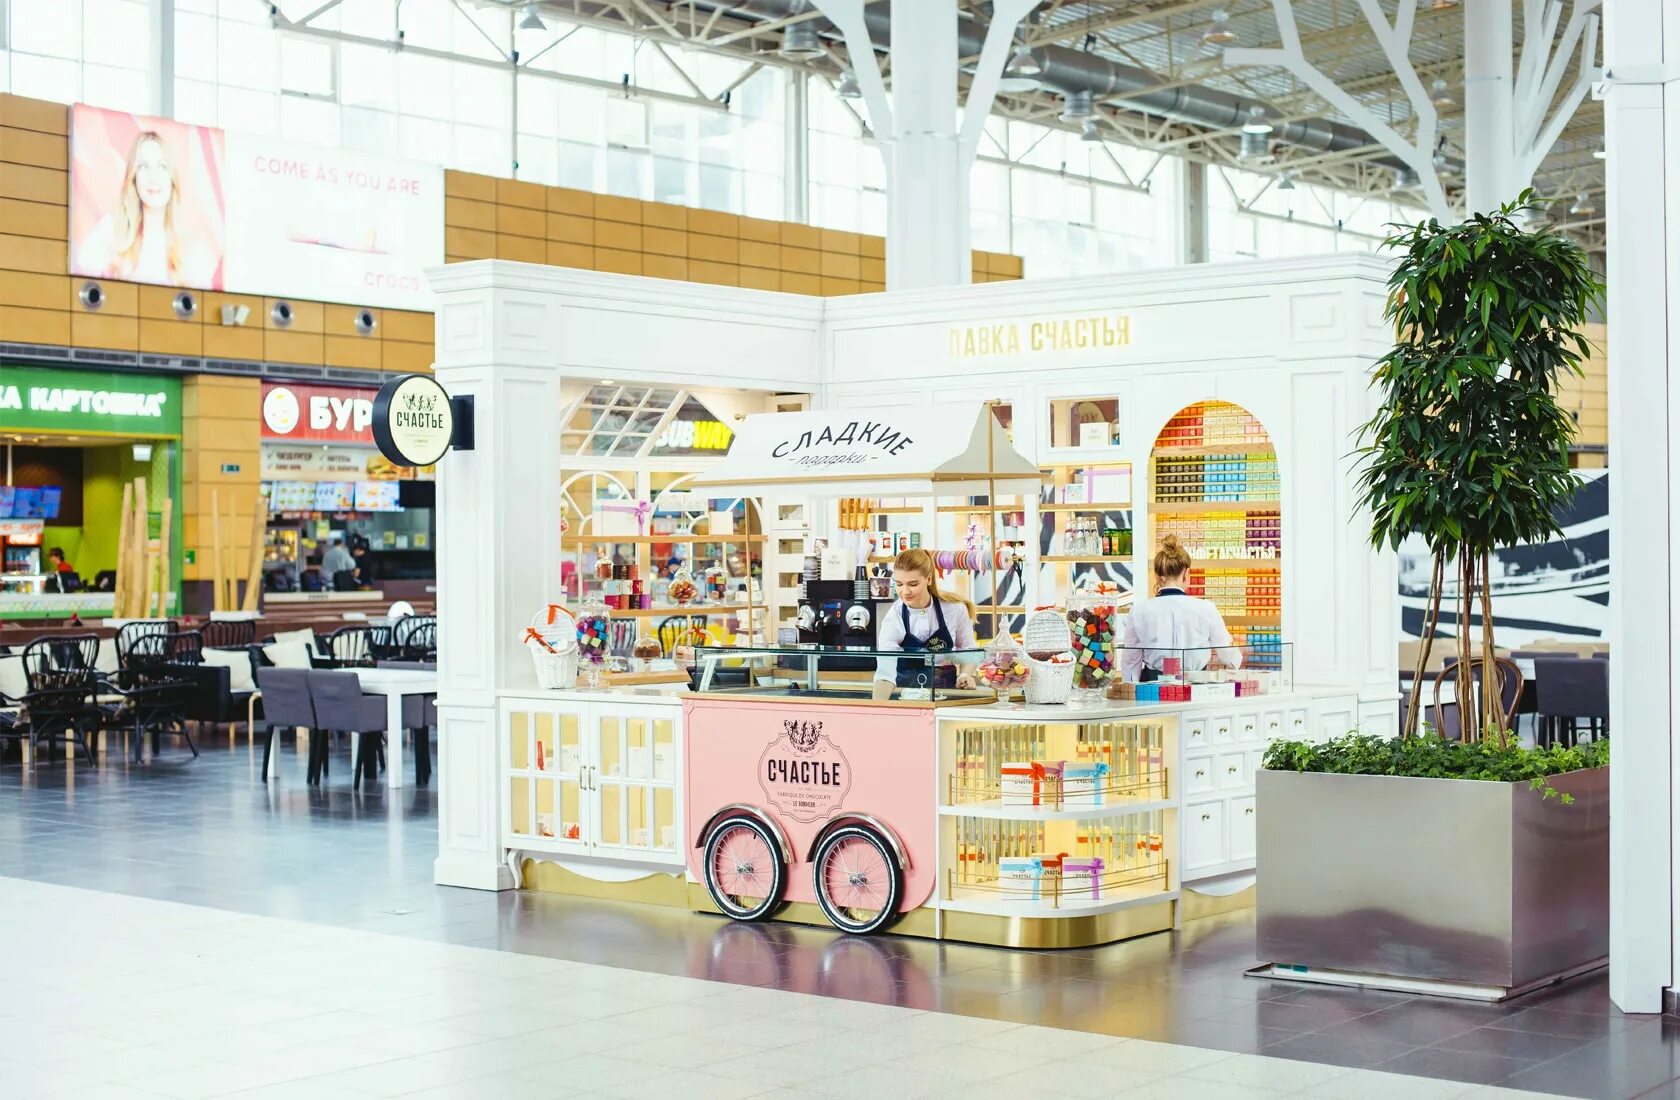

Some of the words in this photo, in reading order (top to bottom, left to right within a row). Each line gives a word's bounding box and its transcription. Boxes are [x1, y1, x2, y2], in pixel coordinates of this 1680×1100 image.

[254, 156, 309, 179] COME
[315, 166, 339, 184] AS
[346, 171, 380, 190] YOU
[387, 177, 420, 196] ARE
[364, 272, 419, 290] crocs
[1031, 315, 1130, 351] СЧАСТЬЯ
[0, 385, 23, 409] А
[30, 387, 162, 417] КАРТОШКА
[396, 411, 444, 428] СЧАСТЬЕ
[772, 421, 914, 458] СЛАДКИЕ
[768, 759, 840, 785] СЧАСТЬЕ
